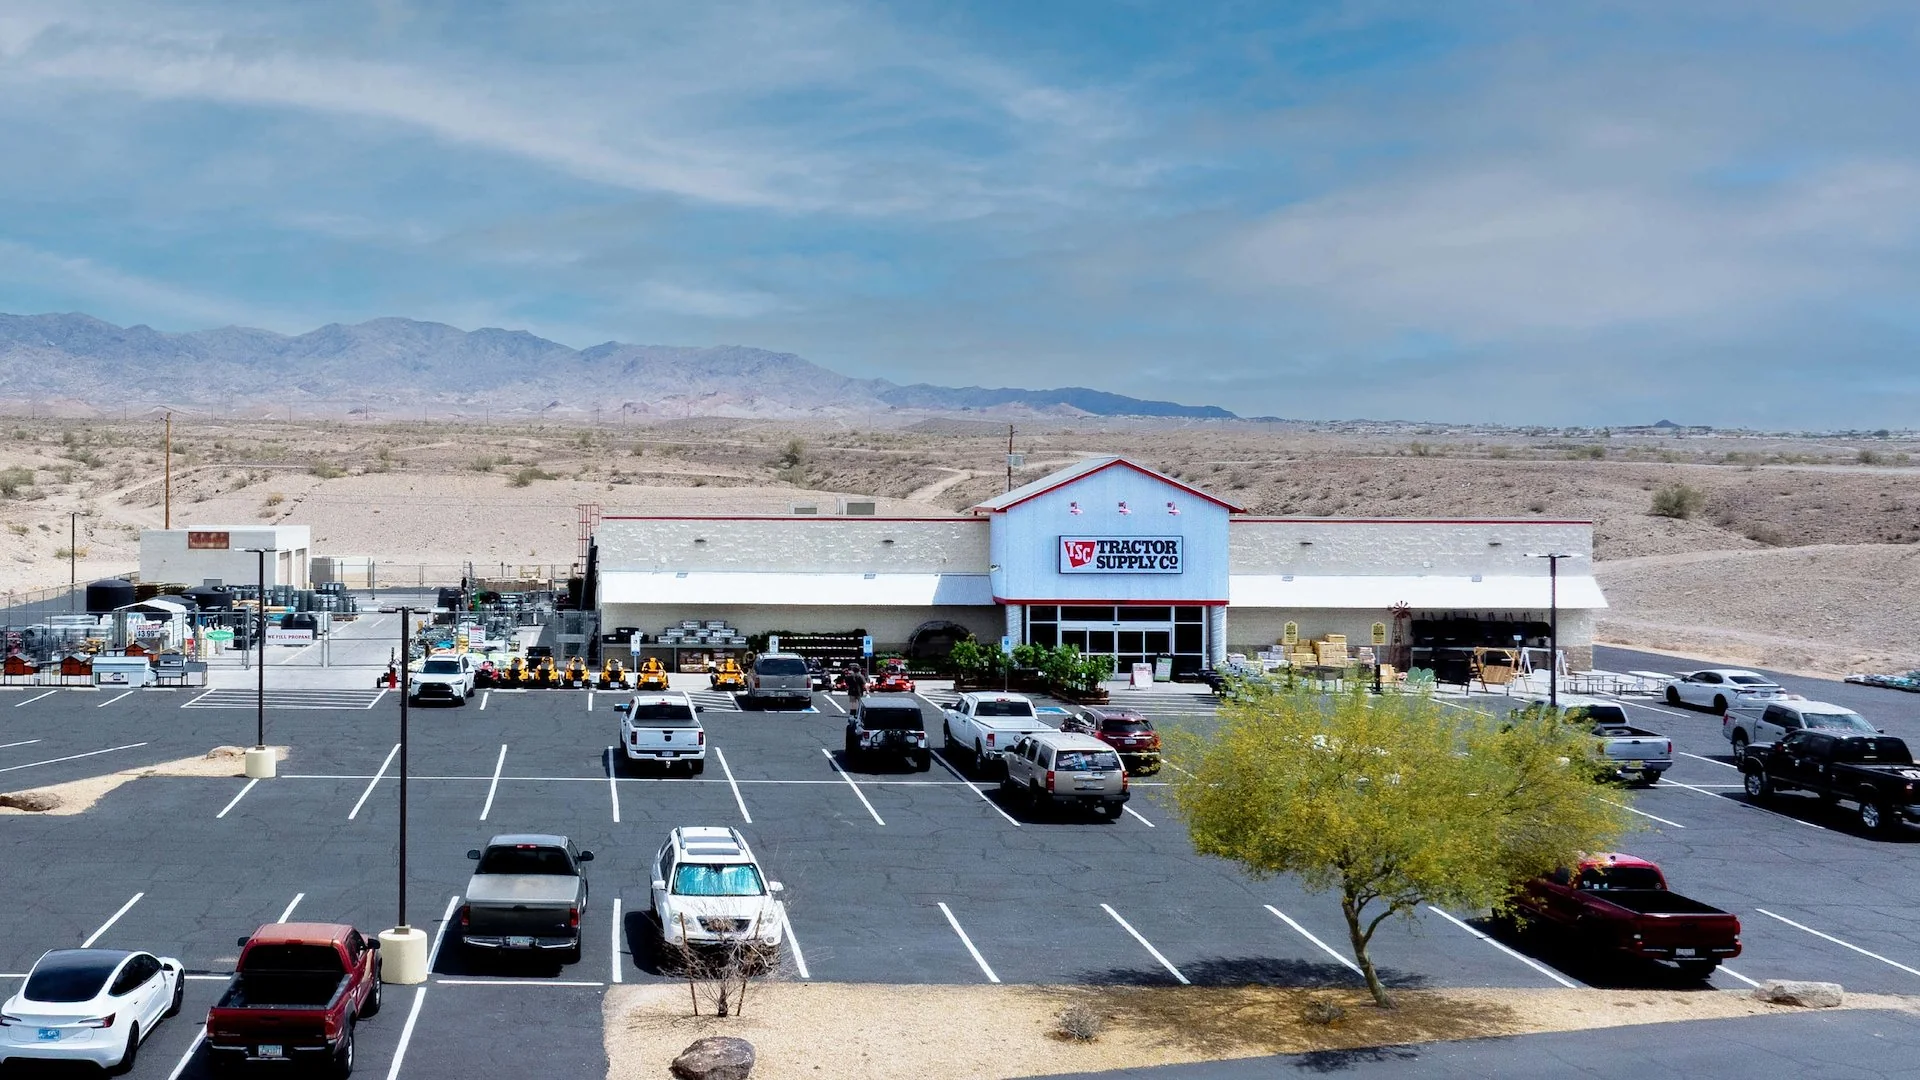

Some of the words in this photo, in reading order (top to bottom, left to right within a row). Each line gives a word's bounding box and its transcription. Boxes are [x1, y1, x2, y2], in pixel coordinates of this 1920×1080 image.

[1067, 542, 1091, 563] TSC
[1096, 540, 1178, 555] TRACTOR
[1096, 555, 1158, 569] SUPPLY
